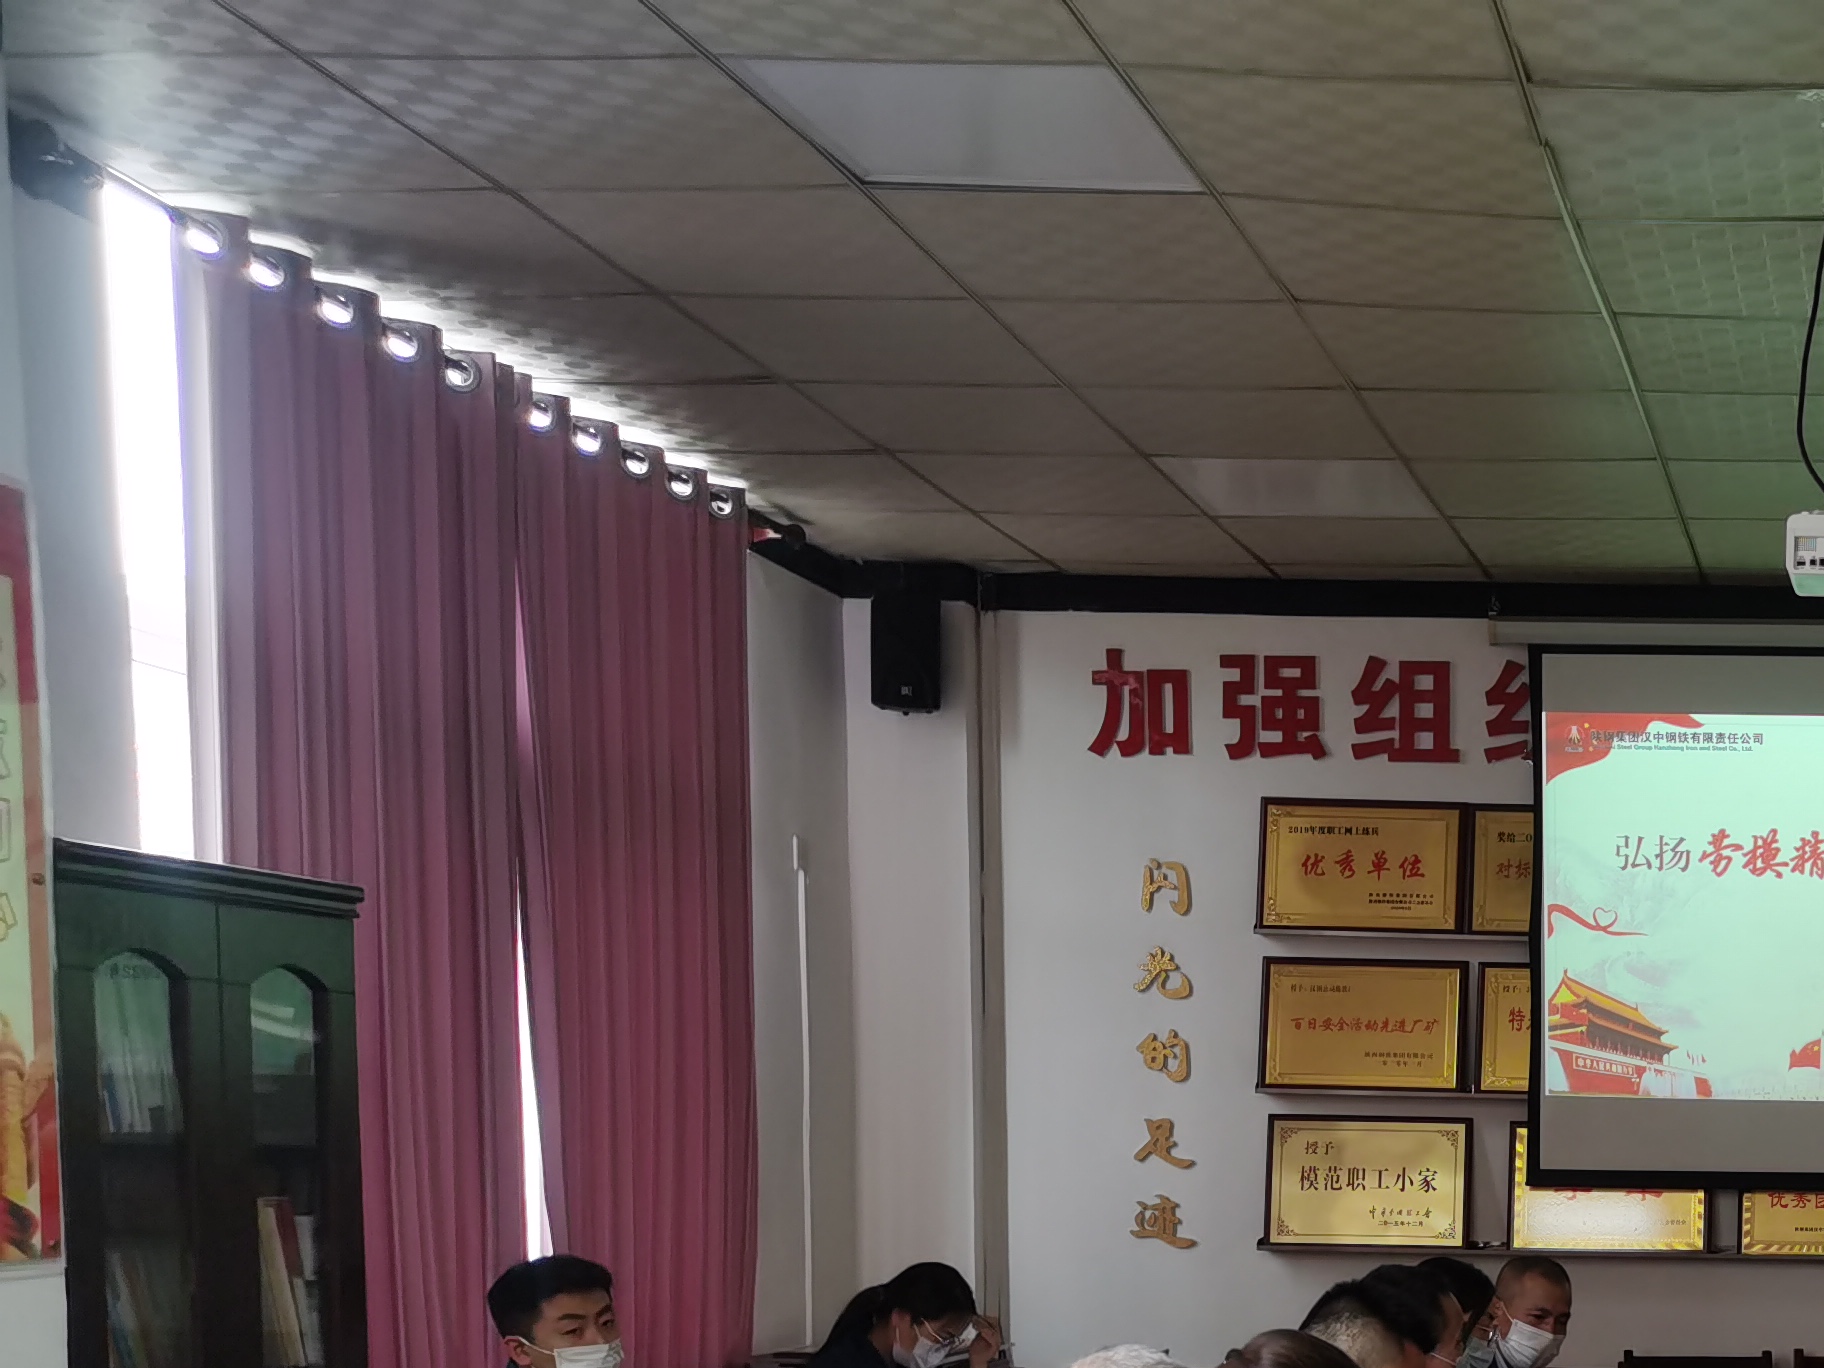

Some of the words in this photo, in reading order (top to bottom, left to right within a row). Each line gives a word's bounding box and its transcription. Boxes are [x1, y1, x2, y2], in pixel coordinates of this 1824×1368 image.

[1301, 849, 1426, 881] 优秀单位
[1508, 1006, 1531, 1032] 特
[1304, 1140, 1335, 1155] 授予
[1298, 1166, 1439, 1194] 模范职工小家
